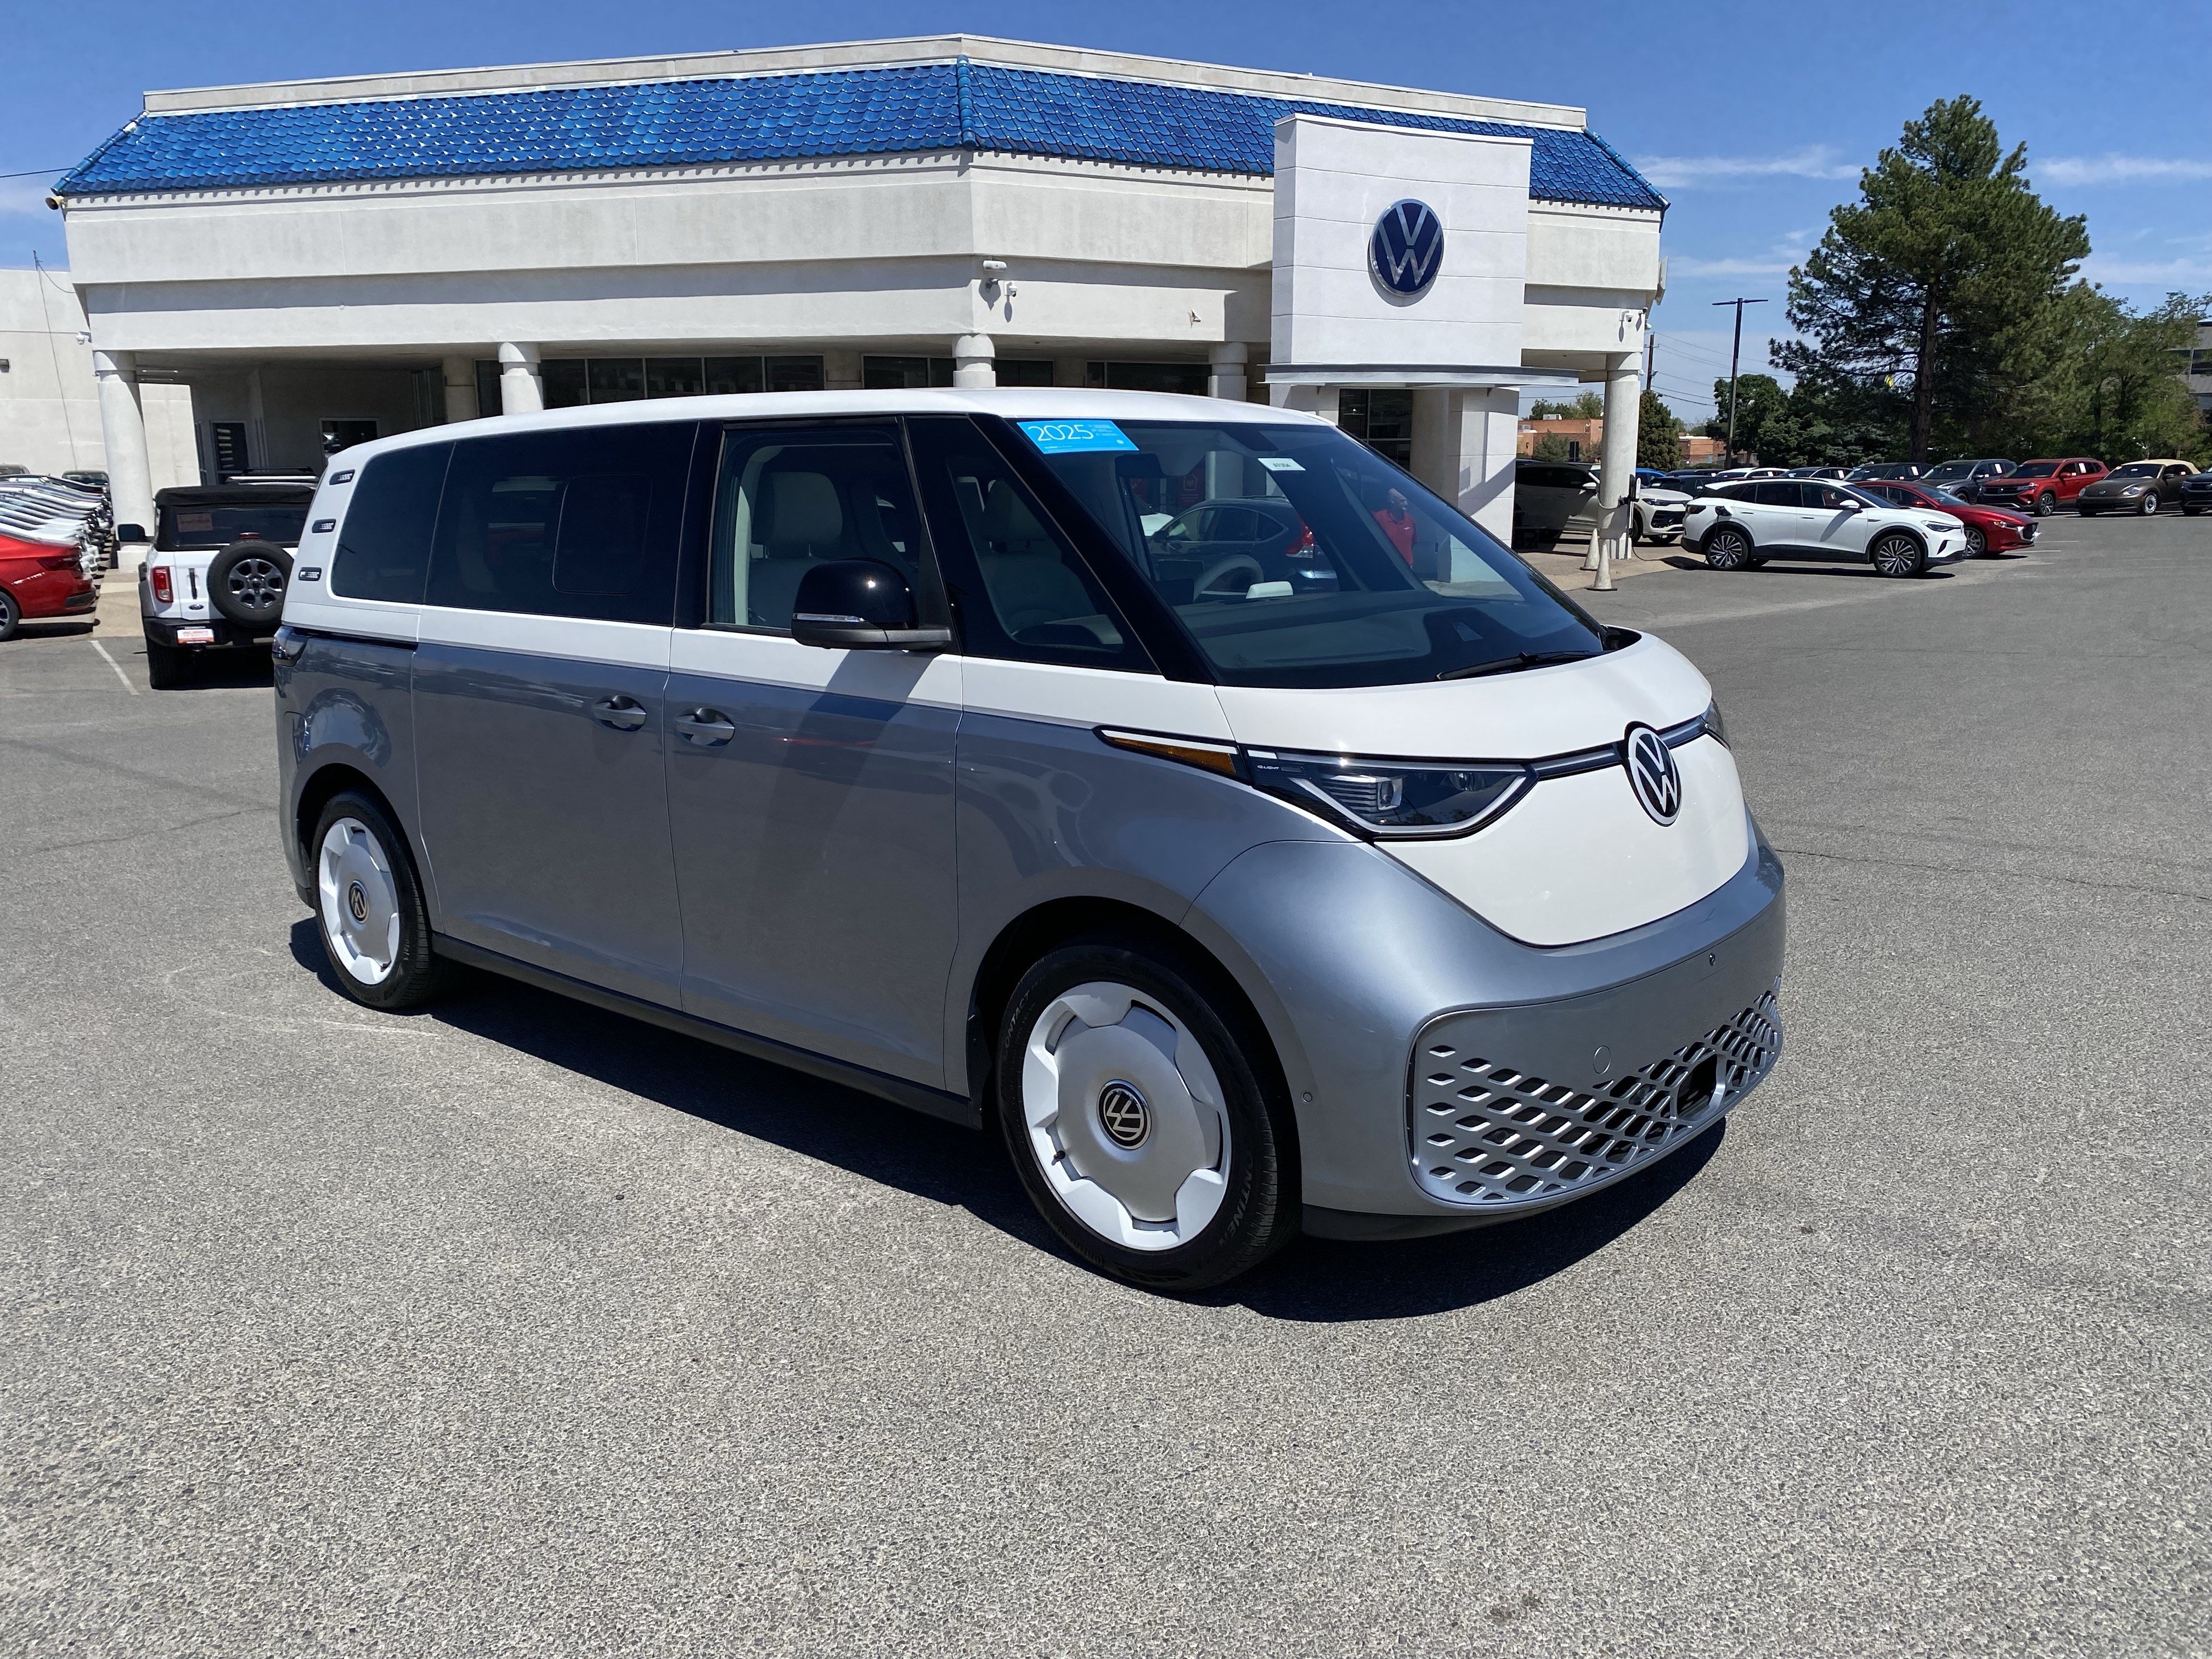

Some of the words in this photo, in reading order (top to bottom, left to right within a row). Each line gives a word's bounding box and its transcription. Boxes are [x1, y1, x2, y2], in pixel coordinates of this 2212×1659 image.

[1376, 202, 1443, 289] VW
[1028, 424, 1093, 441] 2025
[1632, 731, 1679, 816] VW
[350, 885, 366, 919] VW
[1104, 1090, 1144, 1139] VW
